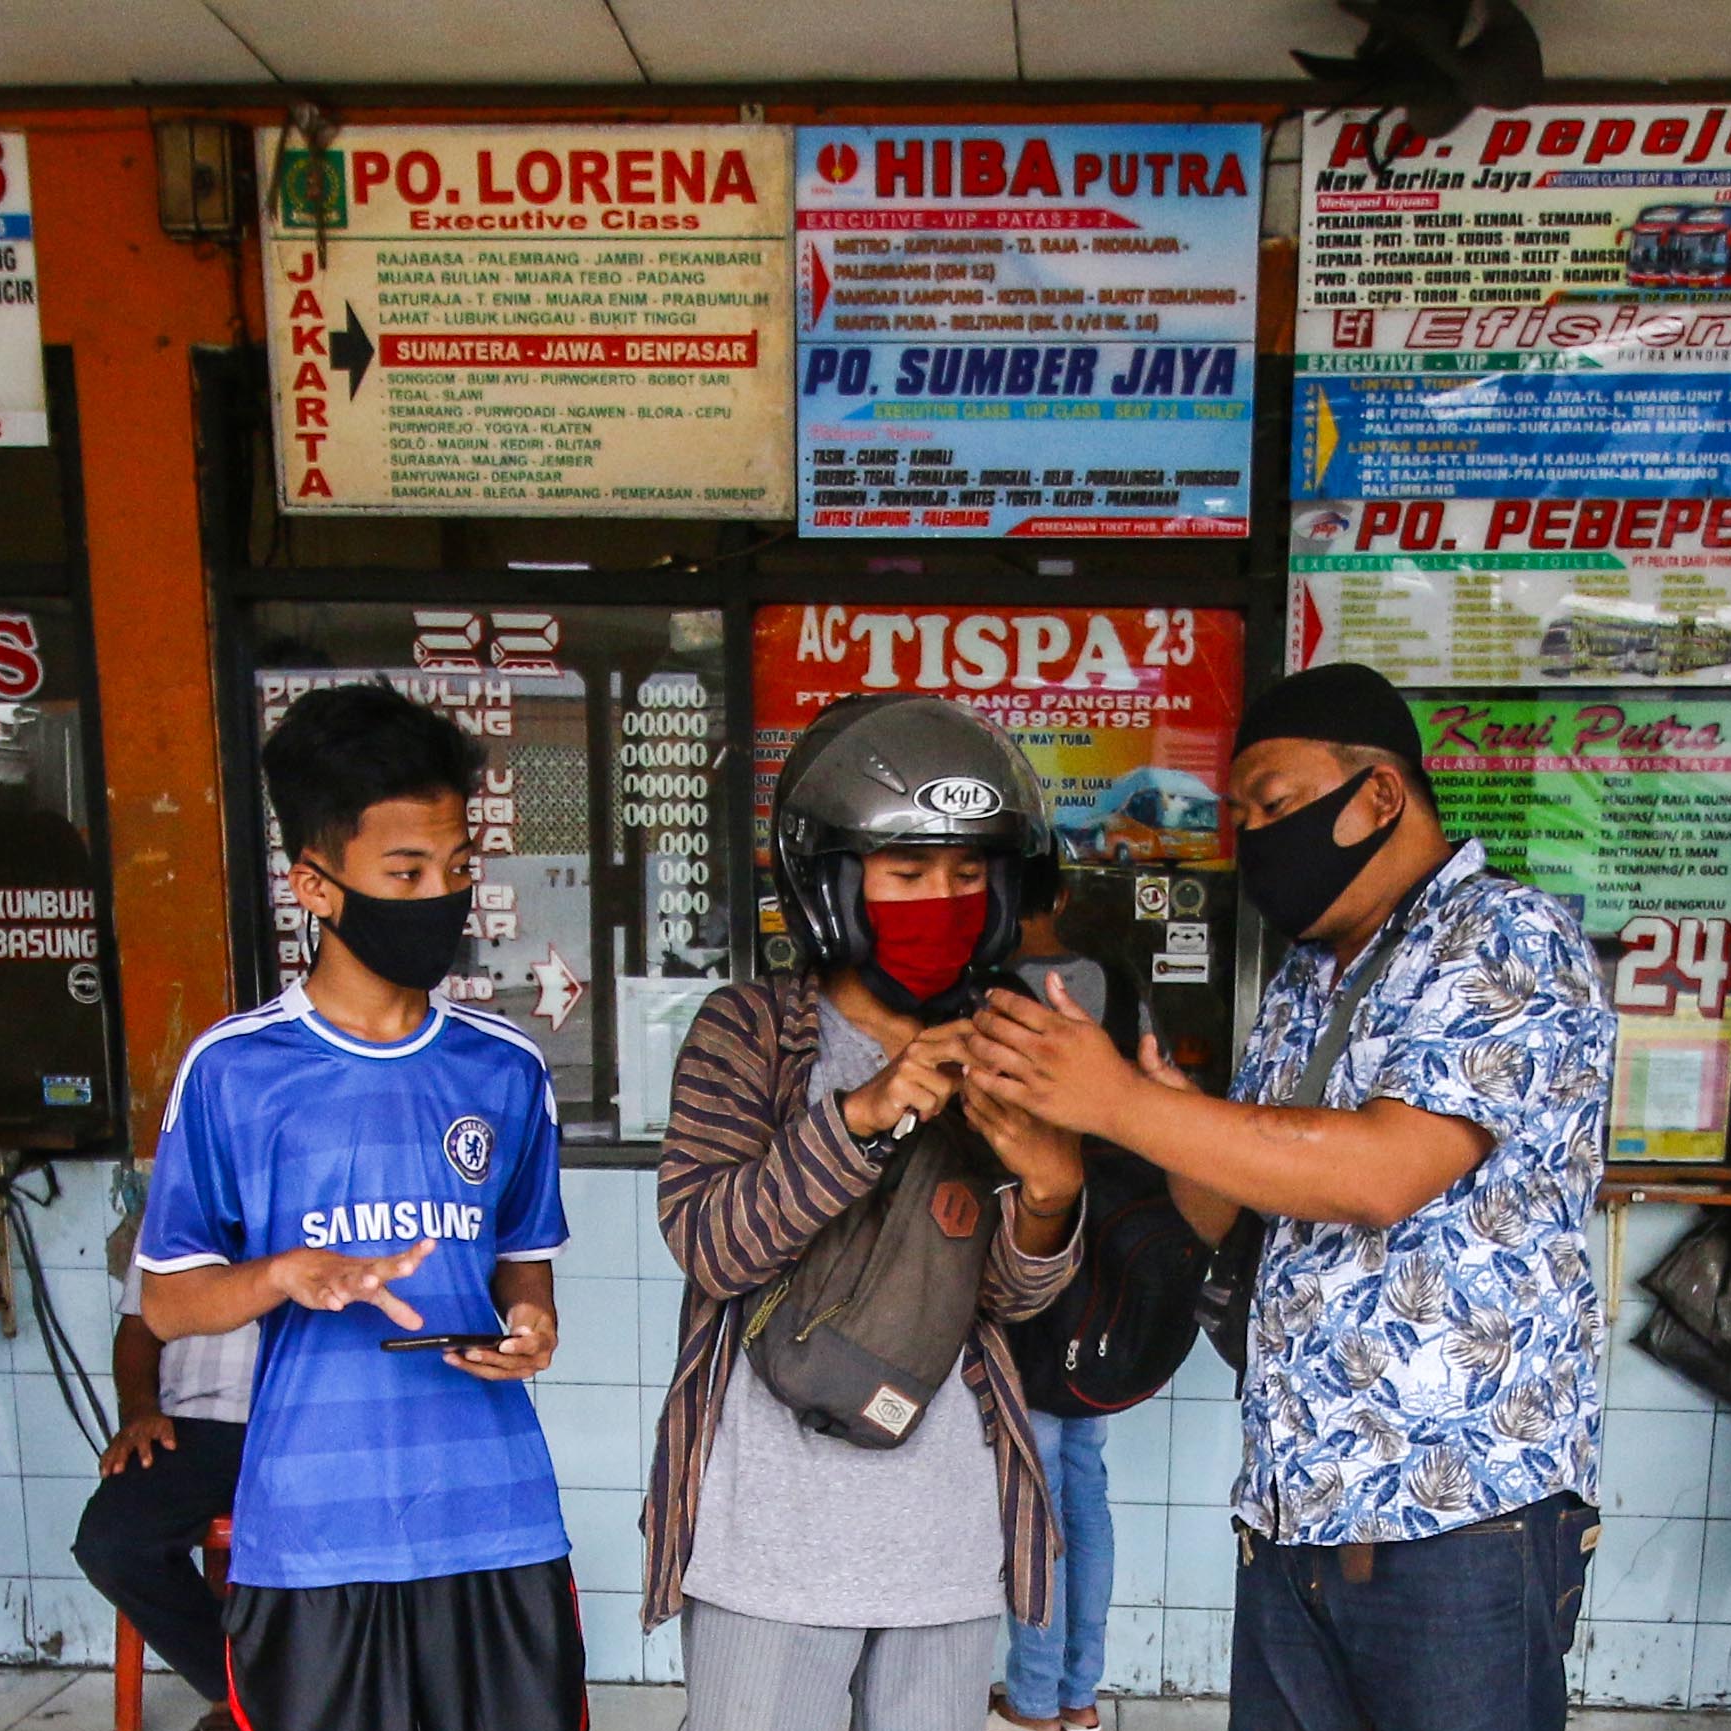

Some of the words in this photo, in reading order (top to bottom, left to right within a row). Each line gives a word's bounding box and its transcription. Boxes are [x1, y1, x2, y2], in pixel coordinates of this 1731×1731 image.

[351, 150, 459, 205] PO.
[477, 149, 758, 205] LORENA
[874, 139, 1062, 198] HIBA
[1074, 153, 1247, 197] PUTRA
[1315, 170, 1371, 193] New
[1376, 168, 1467, 190] Berlian
[1472, 168, 1533, 190] Jaya
[409, 210, 588, 232] Executive
[600, 210, 701, 232] Class
[806, 212, 924, 229] EXECUTIVE
[943, 213, 976, 228] VIP
[996, 212, 1062, 229] PATAS
[376, 253, 465, 267] RAJABASA
[478, 253, 579, 267] PALEMBANG
[594, 253, 644, 267] JAMBI
[376, 271, 435, 285] MUARA
[515, 272, 573, 285] MUARA
[579, 272, 622, 285] TEBO
[636, 272, 705, 285] PADANG
[379, 312, 430, 325] LAHAT
[445, 312, 498, 325] LUBUK
[502, 312, 575, 326] LINGGAU
[590, 312, 640, 325] BUKIT
[643, 312, 697, 325] TINGGI
[287, 252, 333, 498] JAKARTA
[396, 342, 520, 362] SUMATERA
[541, 341, 604, 362] JAWA
[626, 341, 747, 362] DENPASAR
[802, 347, 879, 397] PO.
[895, 347, 1100, 397] SUMBER
[1111, 347, 1238, 397] JAYA
[1354, 501, 1456, 552] PO.
[412, 610, 565, 677] 22
[796, 604, 847, 664] AC
[850, 612, 1140, 691] TISPA
[1143, 608, 1196, 667] 23
[1045, 693, 1191, 711] PANGERAN
[1428, 704, 1555, 752] Krui
[1571, 703, 1726, 755] Putra
[301, 1200, 485, 1250] SAMSUNG
